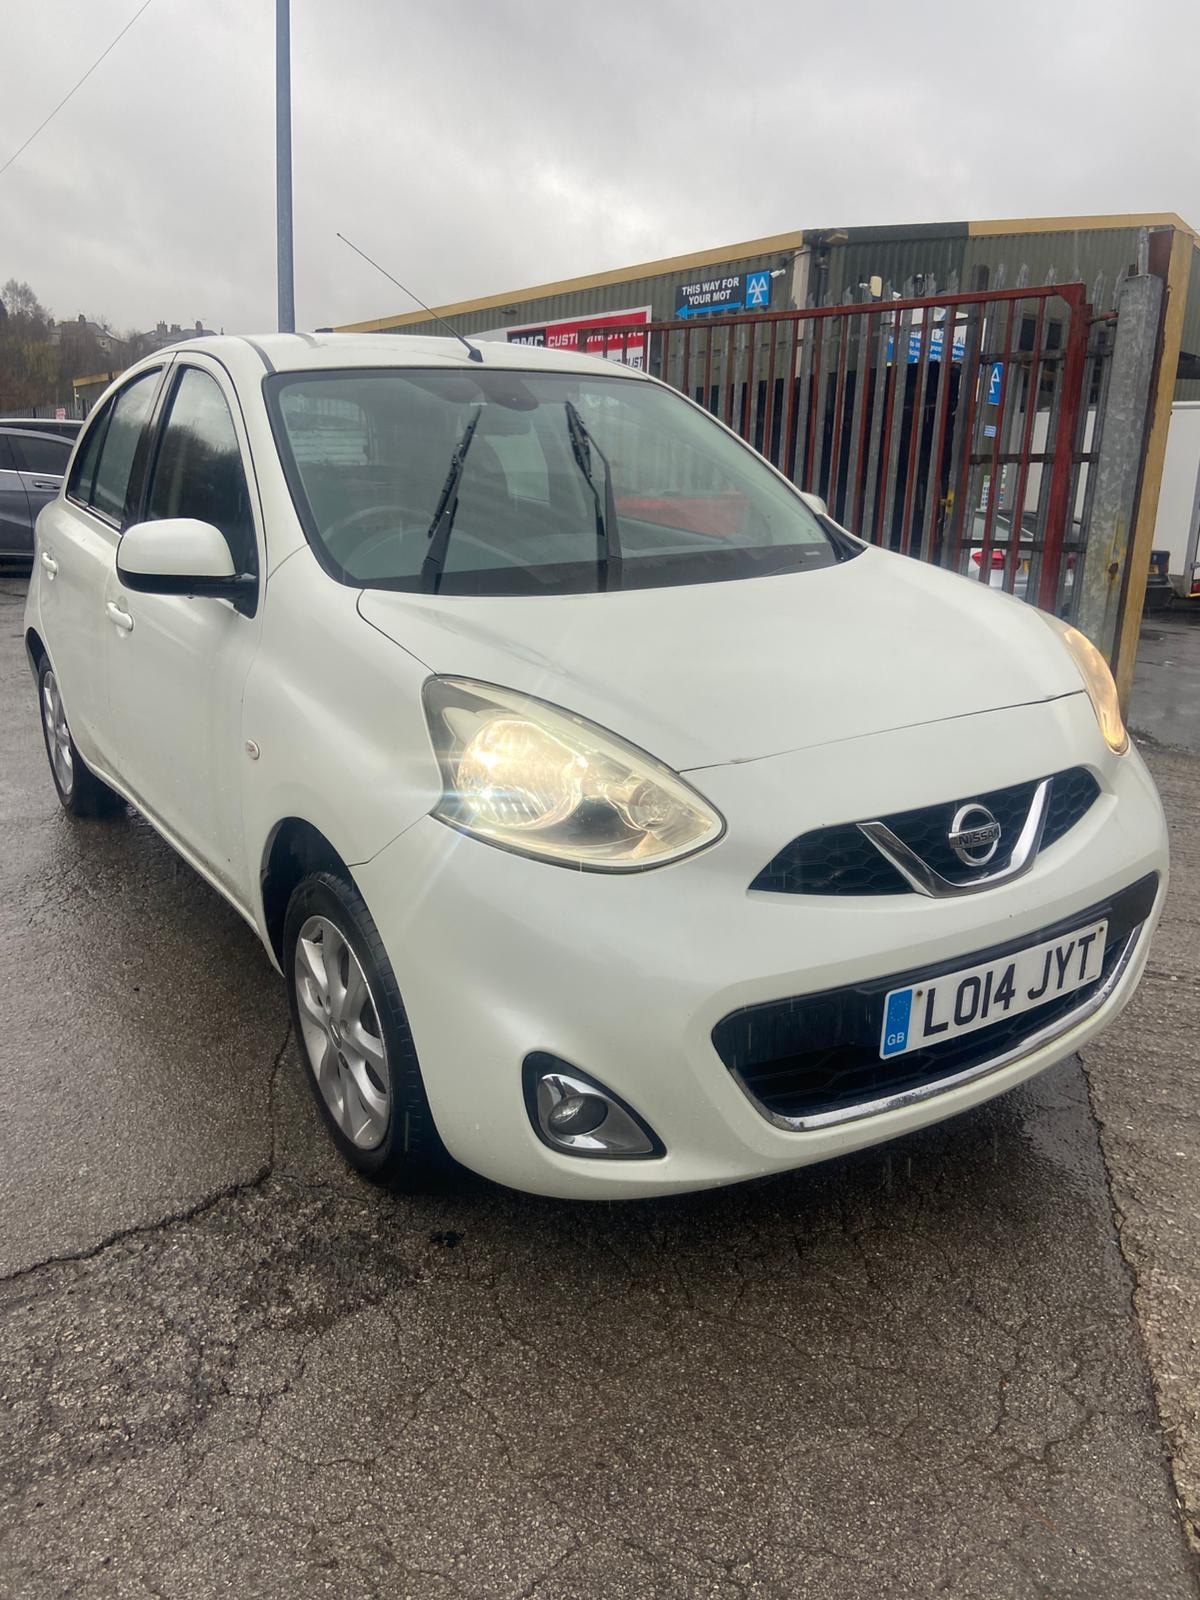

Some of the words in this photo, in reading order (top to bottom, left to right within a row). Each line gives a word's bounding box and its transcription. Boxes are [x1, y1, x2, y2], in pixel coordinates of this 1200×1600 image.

[682, 284, 700, 296] THIS
[702, 280, 721, 292] WAY
[722, 276, 740, 289] FOR
[688, 293, 711, 305] YOUR
[712, 289, 732, 302] MOT
[959, 828, 996, 844] NISSAN
[923, 963, 1016, 1037] LO14
[1027, 932, 1097, 1000] JYT
[887, 1031, 905, 1046] GB
